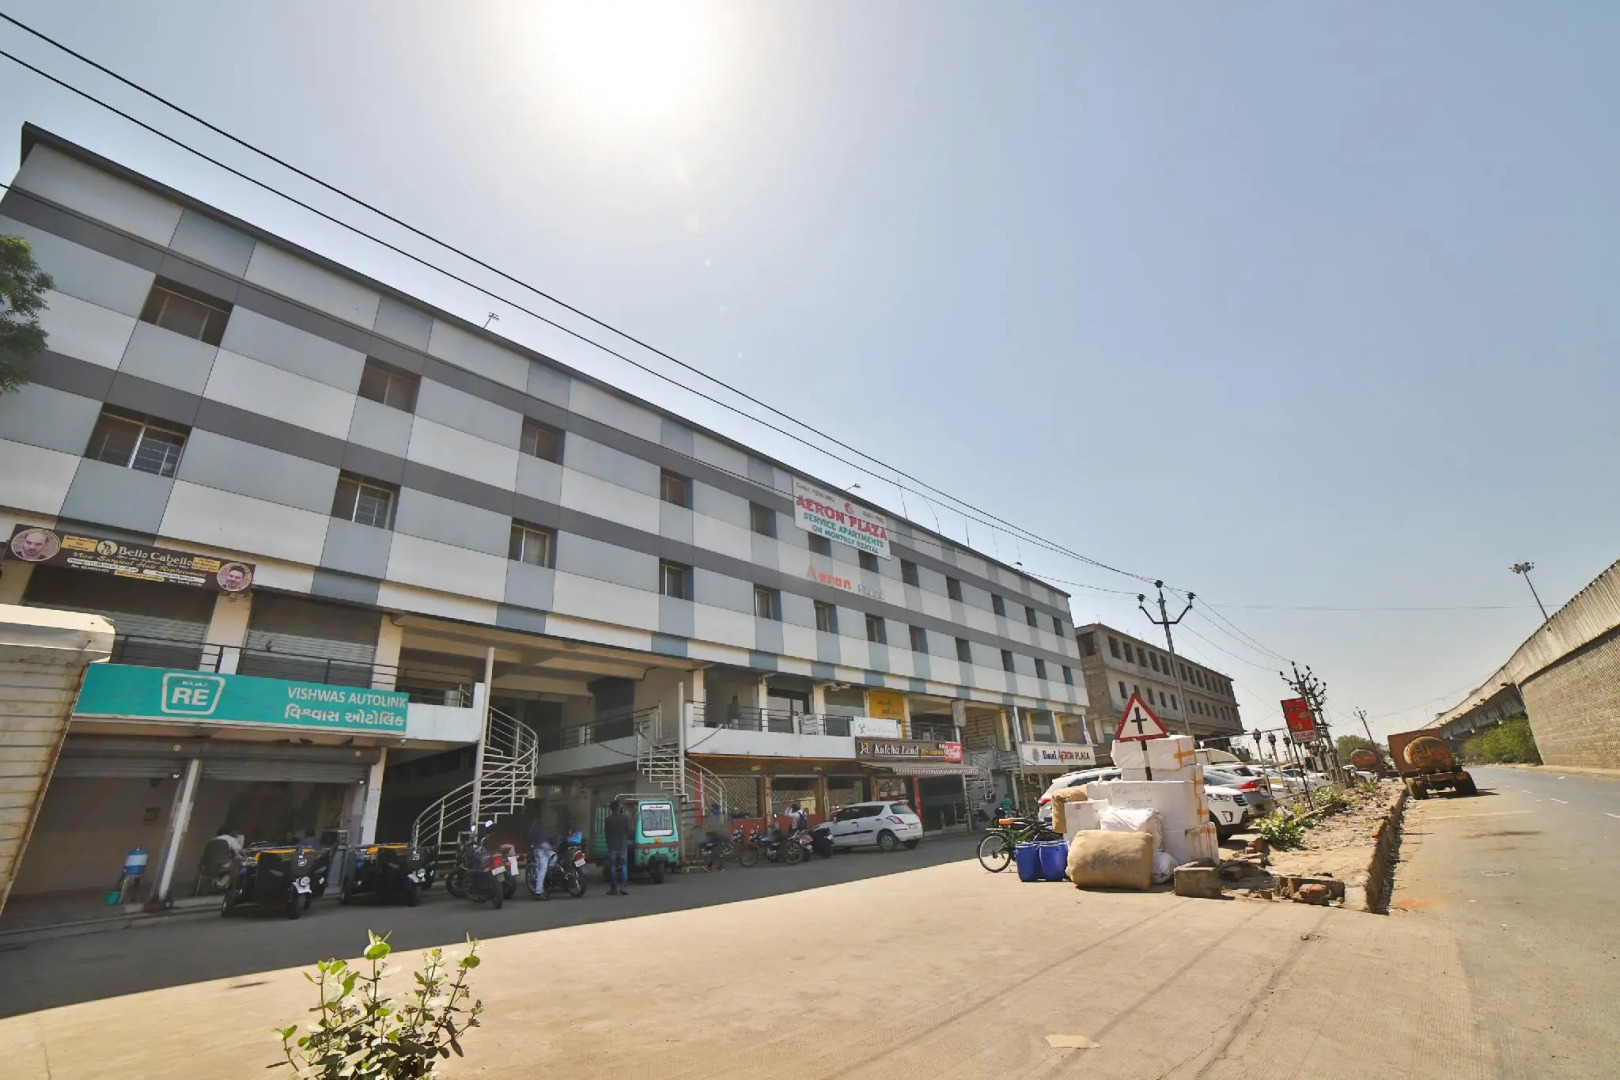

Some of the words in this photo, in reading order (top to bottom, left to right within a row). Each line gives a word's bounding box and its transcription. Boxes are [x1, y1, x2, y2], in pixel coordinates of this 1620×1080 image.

[796, 494, 845, 524] AERON
[849, 515, 887, 540] PLAZA
[803, 511, 836, 531] SERVICE
[839, 526, 884, 548] APARTMENTS
[812, 524, 823, 534] ON
[824, 529, 855, 546] MONTHLY
[856, 540, 879, 554] RENTAL
[118, 546, 148, 559] Bello
[150, 552, 193, 566] Cabello
[171, 687, 210, 706] RE
[287, 686, 346, 703] VISHWAS
[347, 692, 406, 709] AUTOLINK
[874, 743, 900, 755] Kulcha
[901, 745, 919, 756] Land
